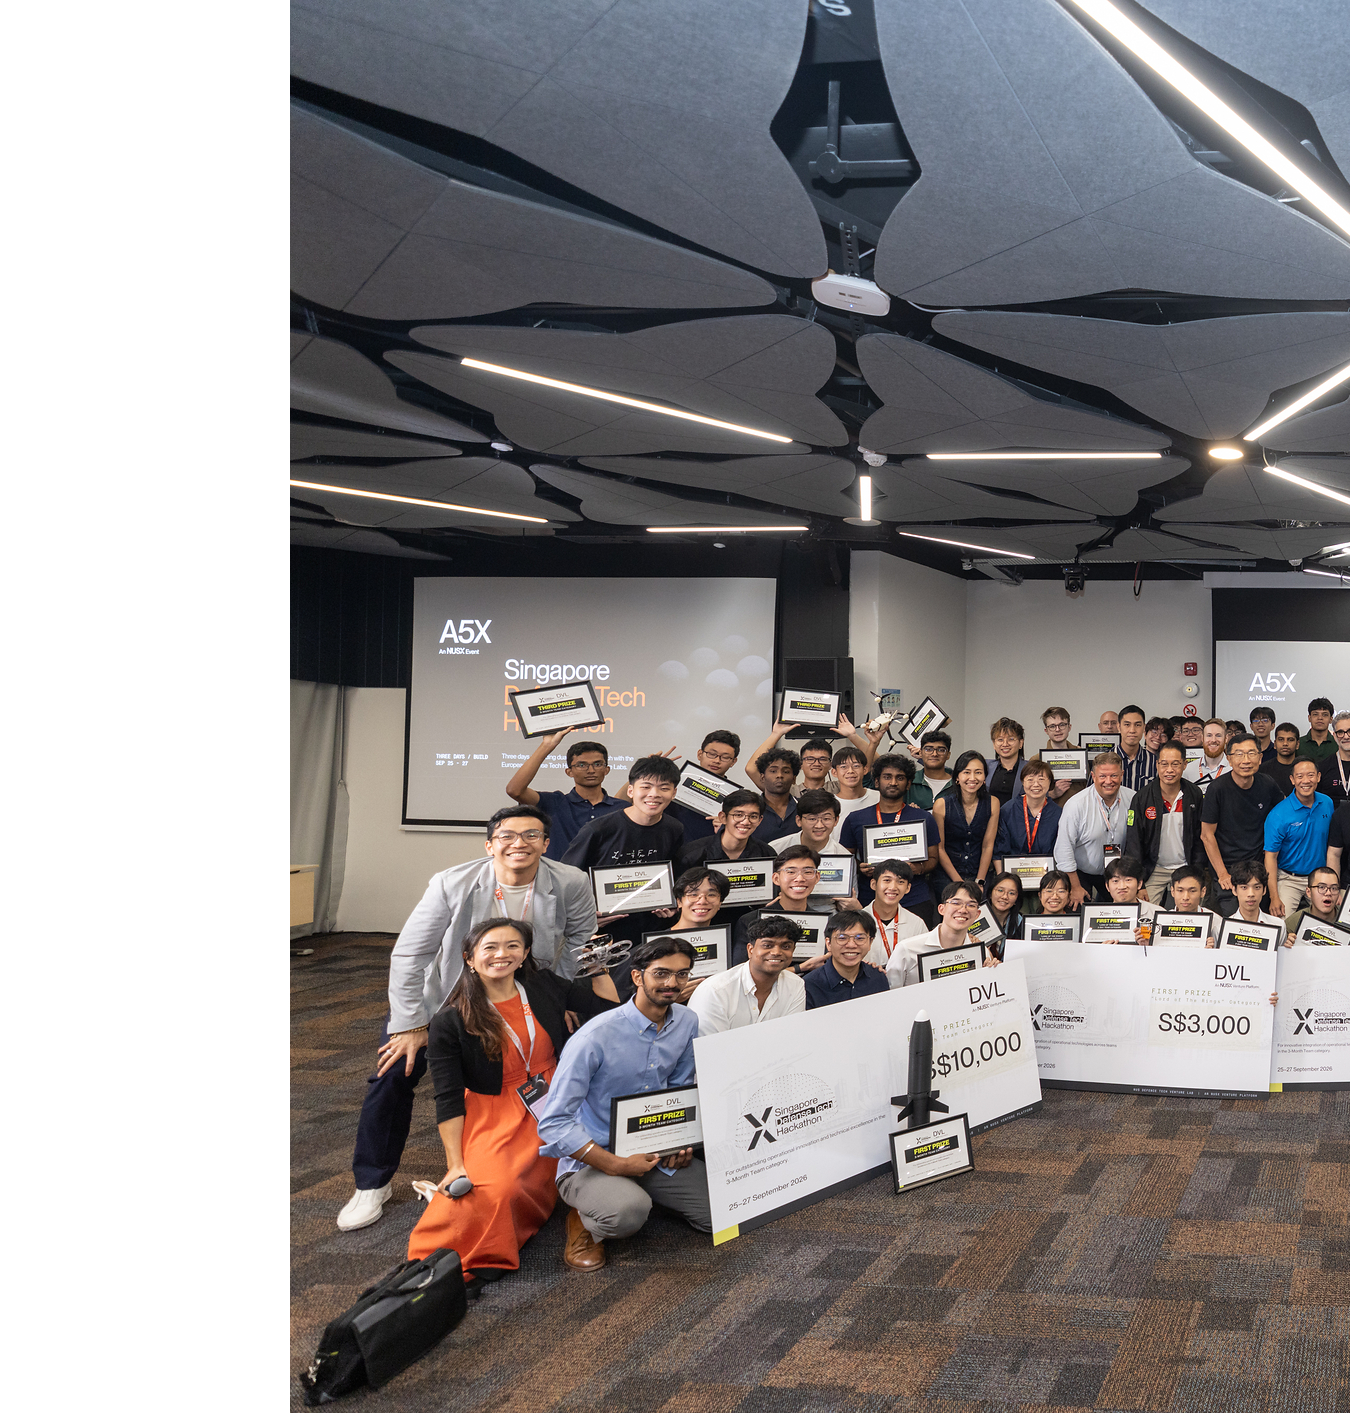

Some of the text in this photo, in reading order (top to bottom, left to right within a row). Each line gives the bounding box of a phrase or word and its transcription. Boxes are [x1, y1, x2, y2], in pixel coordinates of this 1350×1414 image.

[439, 620, 492, 644] A5X
[504, 659, 610, 684] Singapore
[1249, 673, 1296, 692] A5X
[538, 700, 576, 711] THIRD PRIZE
[595, 686, 645, 707] Tech
[877, 837, 899, 845] SECOND
[938, 963, 968, 974] FIRST PRIZE
[1215, 965, 1250, 981] DVL
[969, 981, 1005, 1005] DVL
[1043, 1007, 1074, 1015] Singapore
[943, 1031, 958, 1040] Team
[962, 1021, 994, 1034] Category
[944, 1018, 971, 1031] PRIZE
[1159, 1012, 1250, 1036] S$3,000
[522, 1085, 534, 1095] A5X
[666, 1098, 681, 1106] DVL
[774, 1097, 818, 1117] Singapore
[639, 1109, 685, 1125] FIRST PRIZE
[775, 1100, 833, 1127] Defense Tech
[776, 1115, 822, 1137] Hackathon
[933, 1129, 945, 1137] DVL
[725, 1168, 734, 1176] For
[736, 1157, 766, 1173] outstanding
[767, 1147, 795, 1162] operational
[795, 1138, 819, 1150] innovation
[830, 1127, 850, 1138] technical
[850, 1119, 873, 1130] excellence
[914, 1139, 950, 1155] FIRST PRIZE
[726, 1172, 749, 1185] 3-Month
[750, 1166, 765, 1176] Team
[752, 1182, 789, 1202] September
[790, 1174, 808, 1186] 2026
